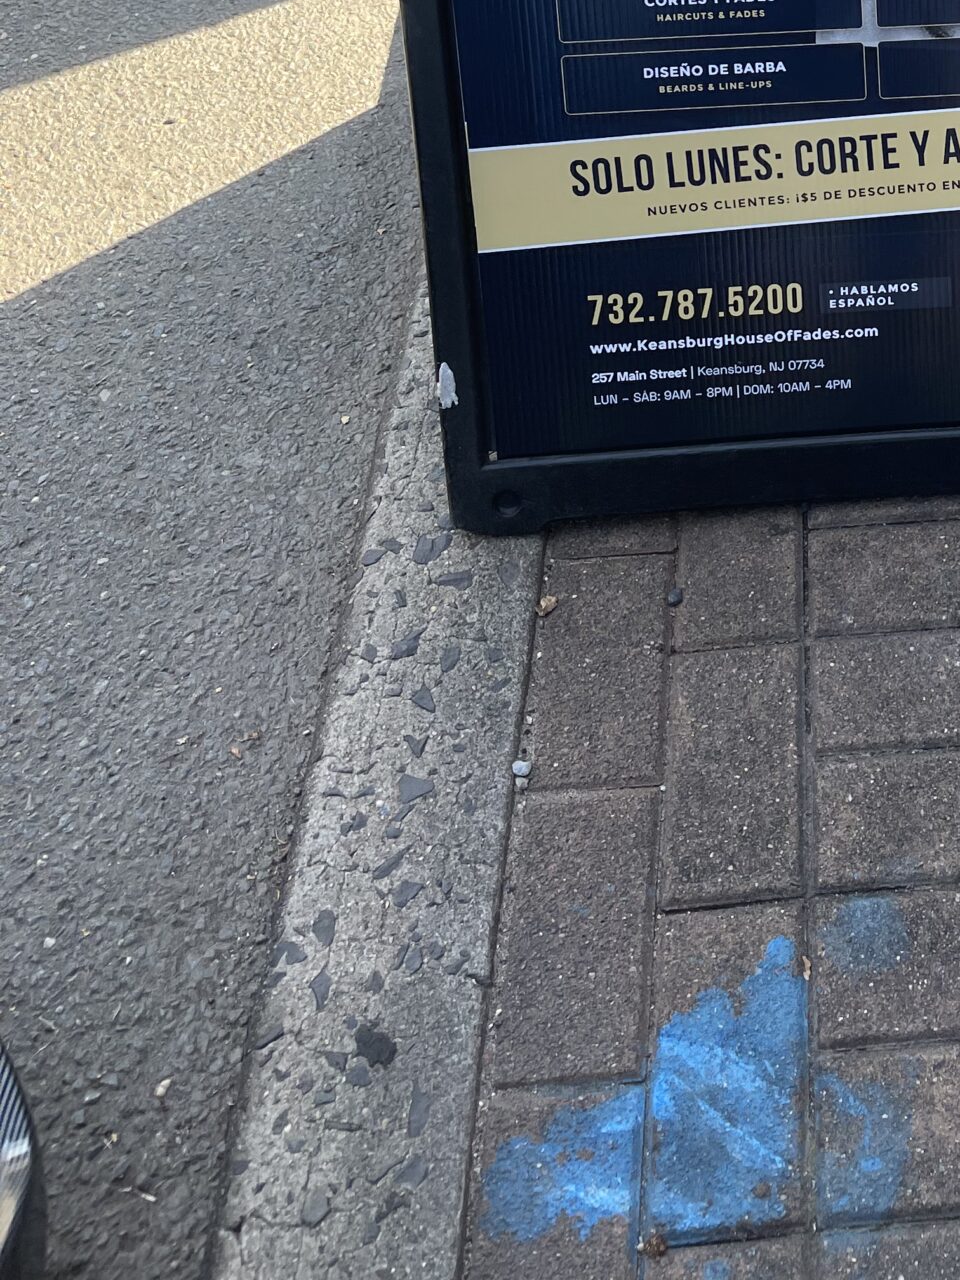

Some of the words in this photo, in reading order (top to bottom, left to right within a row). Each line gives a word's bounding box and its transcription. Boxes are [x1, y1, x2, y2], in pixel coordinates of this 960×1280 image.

[656, 12, 714, 22] HAIRCUTS
[718, 11, 725, 19] &
[729, 9, 765, 19] FADES
[643, 63, 703, 79] DISEÑO
[708, 64, 729, 75] DE
[733, 61, 787, 74] BARBA
[659, 83, 704, 94] BEARDS
[719, 80, 772, 90] LINE-UPS
[569, 153, 655, 198] SOLO
[666, 142, 783, 189] LUNES:
[795, 131, 900, 177] CORTE
[909, 130, 931, 167] Y
[647, 201, 708, 217] NUEVOS
[714, 195, 791, 211] CLIENTES:
[824, 190, 842, 200] DE
[848, 182, 936, 198] DESCUENTO
[942, 179, 960, 190] EN
[840, 282, 919, 296] HABLAMOS
[587, 283, 804, 326] 732.787.5200
[829, 295, 895, 309] ESPAÑOL
[590, 325, 880, 355] www.KeansburgHouseOfFades.com
[591, 372, 614, 383] 257
[617, 370, 647, 382] Main
[649, 367, 687, 380] Street
[697, 362, 766, 377] Keansburg,
[769, 361, 785, 372] NJ
[788, 359, 825, 371] 07734
[593, 394, 618, 405] LUN
[663, 389, 691, 401] 9AM
[706, 386, 733, 398] 8PM
[743, 384, 774, 395] DOM:
[777, 381, 810, 393] 10AM
[825, 379, 852, 390] 4PM
